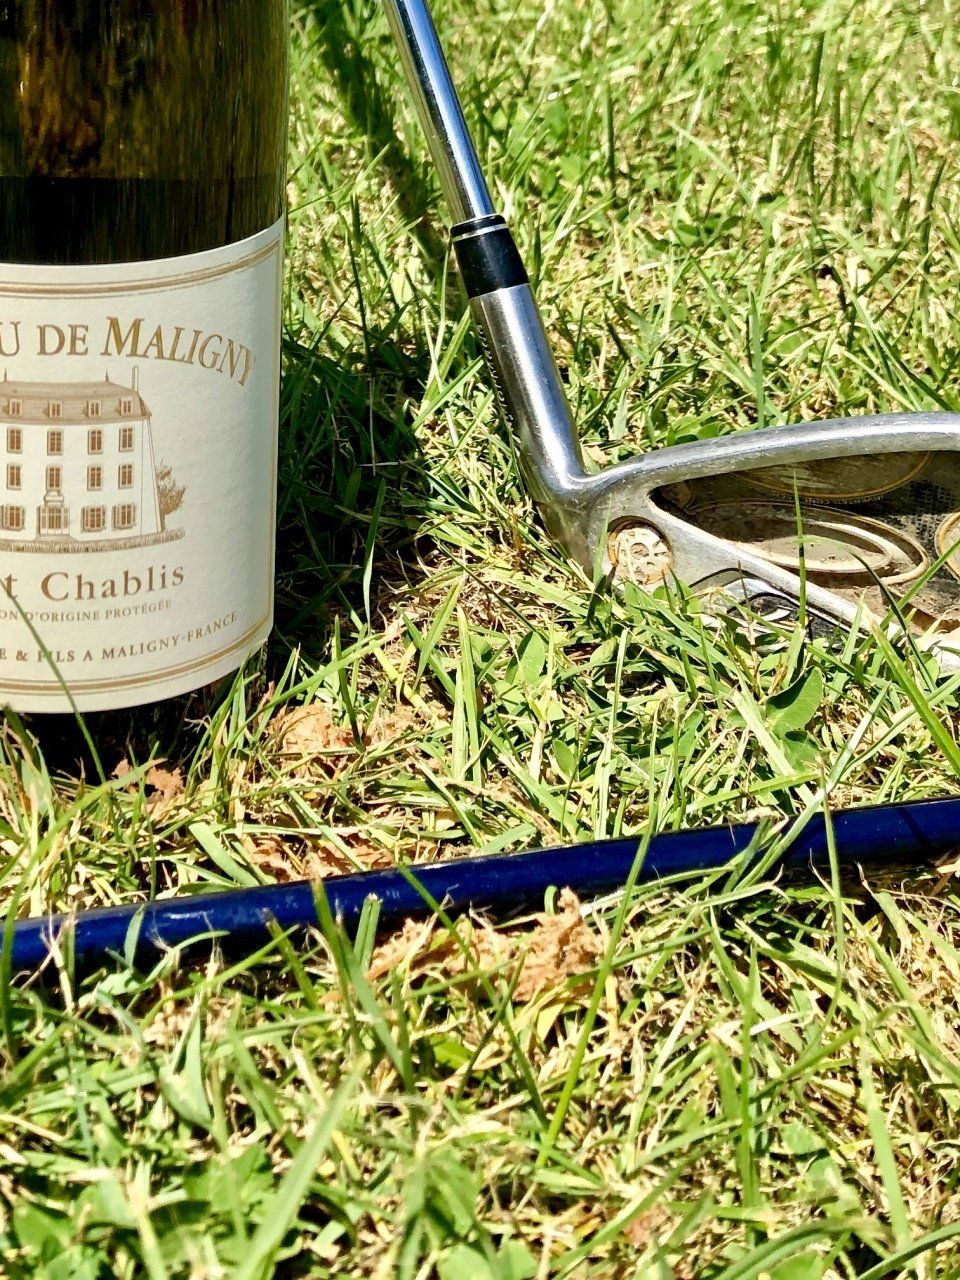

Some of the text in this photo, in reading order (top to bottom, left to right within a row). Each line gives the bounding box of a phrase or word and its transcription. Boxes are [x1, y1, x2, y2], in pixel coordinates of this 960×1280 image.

[36, 323, 89, 356] DE
[100, 316, 257, 387] MALIGNY
[40, 564, 184, 602] Chablis
[24, 610, 100, 622] D'ORIGINE
[105, 598, 173, 620] PROTÉGÉE
[15, 649, 28, 662] &
[83, 649, 93, 661] A
